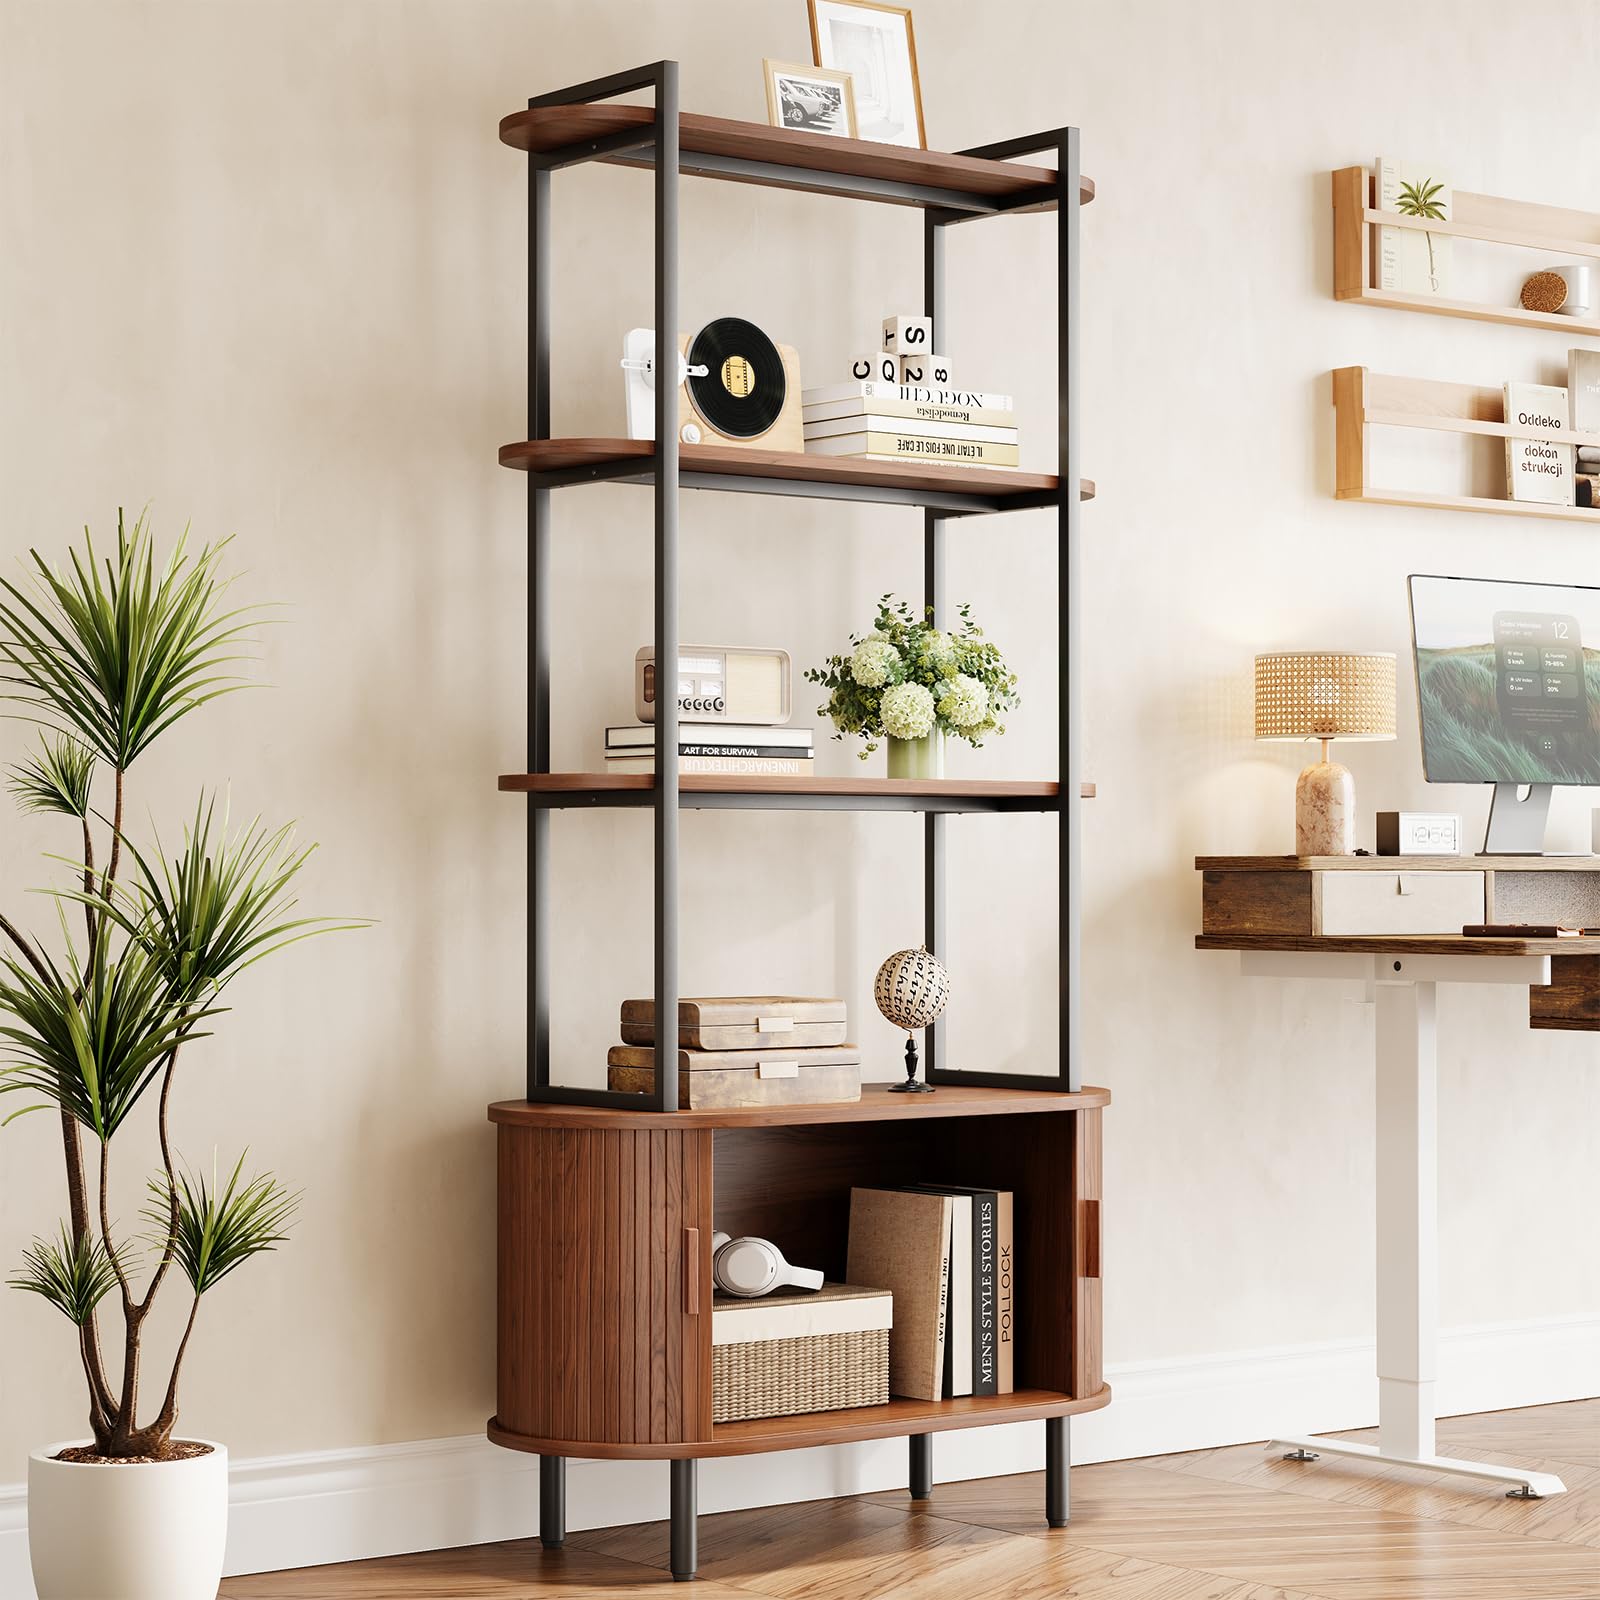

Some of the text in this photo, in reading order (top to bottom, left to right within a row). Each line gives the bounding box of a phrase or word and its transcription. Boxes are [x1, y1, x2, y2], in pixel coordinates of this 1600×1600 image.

[885, 328, 895, 347] T
[904, 326, 926, 344] S
[852, 360, 871, 380] C
[882, 359, 895, 383] Q
[905, 367, 923, 383] 2
[934, 368, 948, 383] 8
[900, 386, 983, 408] NOGUCHI
[916, 406, 970, 422] Remodelista
[1518, 412, 1561, 429] Oddeko
[897, 439, 983, 459] IL ÉTAIT UNE FOIS LE CAFÉ
[1524, 445, 1558, 459] dokon
[1521, 461, 1563, 477] strukcji
[1551, 621, 1569, 640] 12
[684, 746, 759, 757] ART FOR SURVIVAL
[684, 759, 799, 773] INNENARCHITEKTUR
[981, 1202, 992, 1384] MEN'S STYLE STORIES
[1001, 1245, 1011, 1342] POLLOCK
